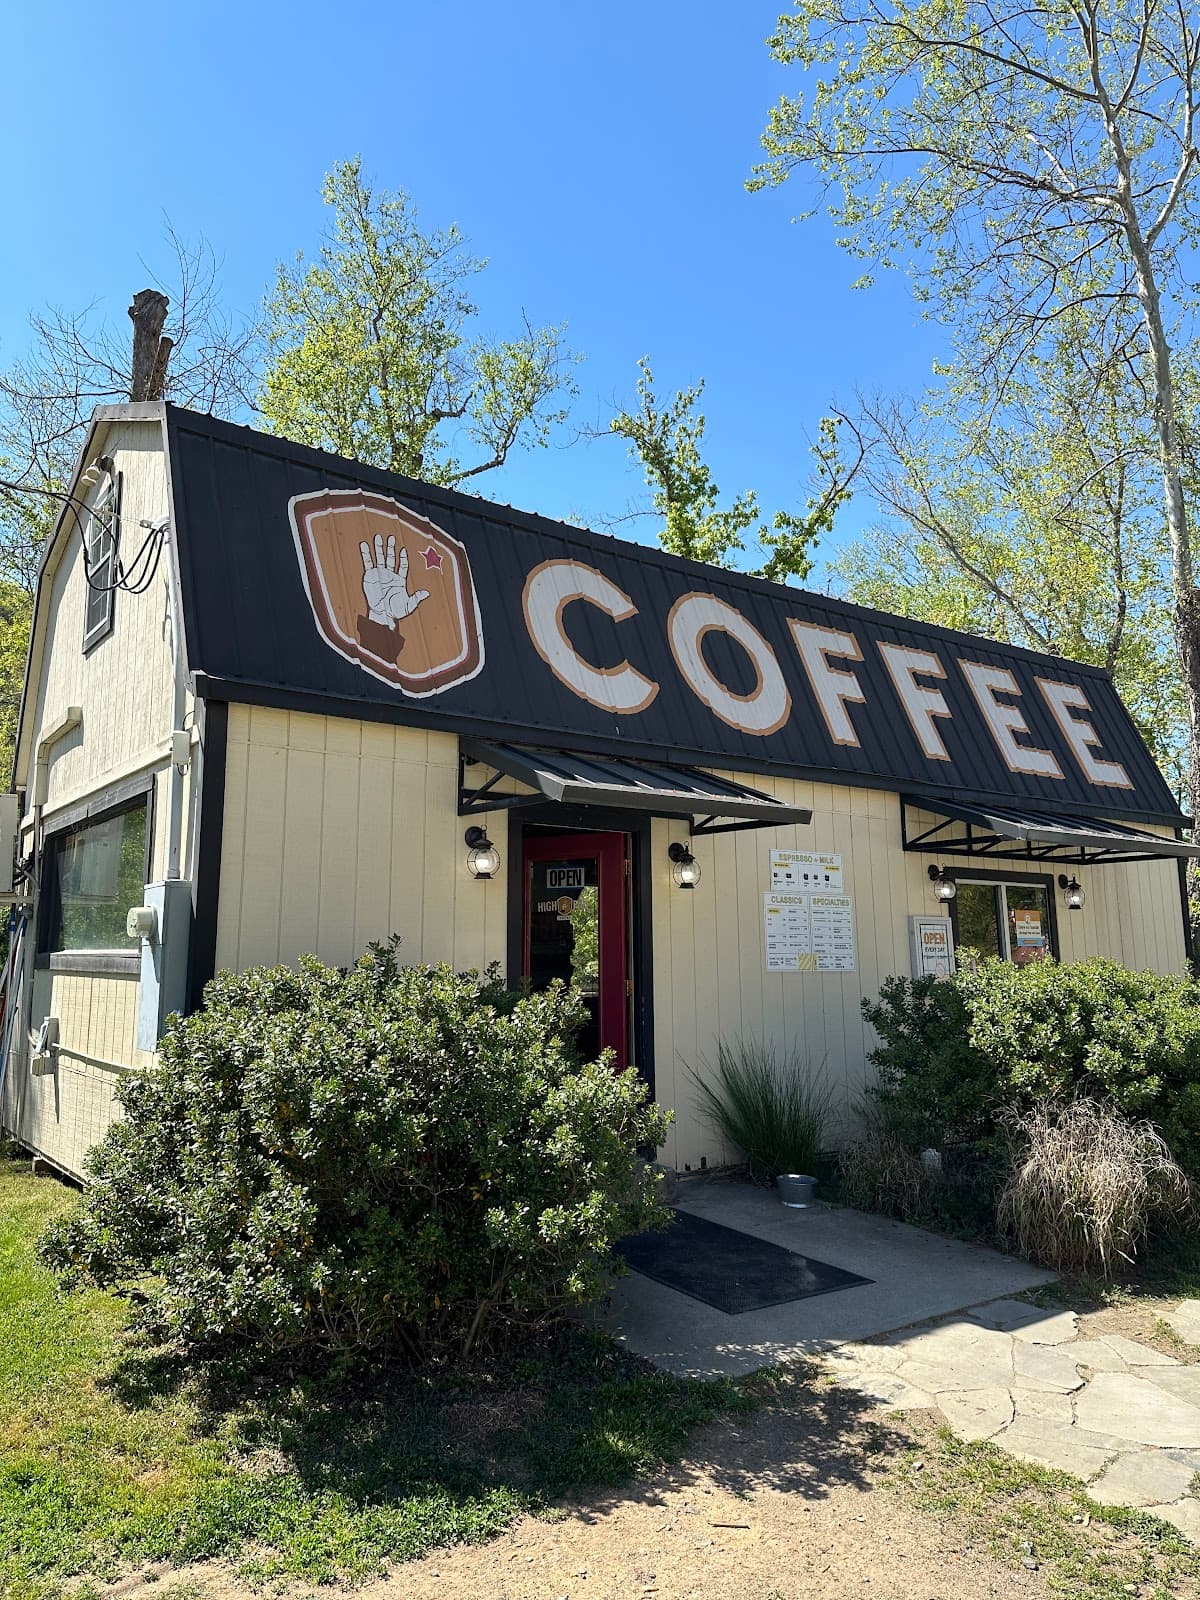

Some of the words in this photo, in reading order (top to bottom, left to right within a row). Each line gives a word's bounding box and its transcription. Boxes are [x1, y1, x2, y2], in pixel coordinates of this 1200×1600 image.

[522, 559, 1134, 789] COFFEE
[779, 854, 813, 863] ESPRESSO
[549, 869, 581, 886] OPEN
[771, 895, 802, 905] CLASSICS
[812, 898, 849, 906] SPECIALTIES
[538, 901, 557, 912] HIGH
[924, 932, 945, 944] OPEN
